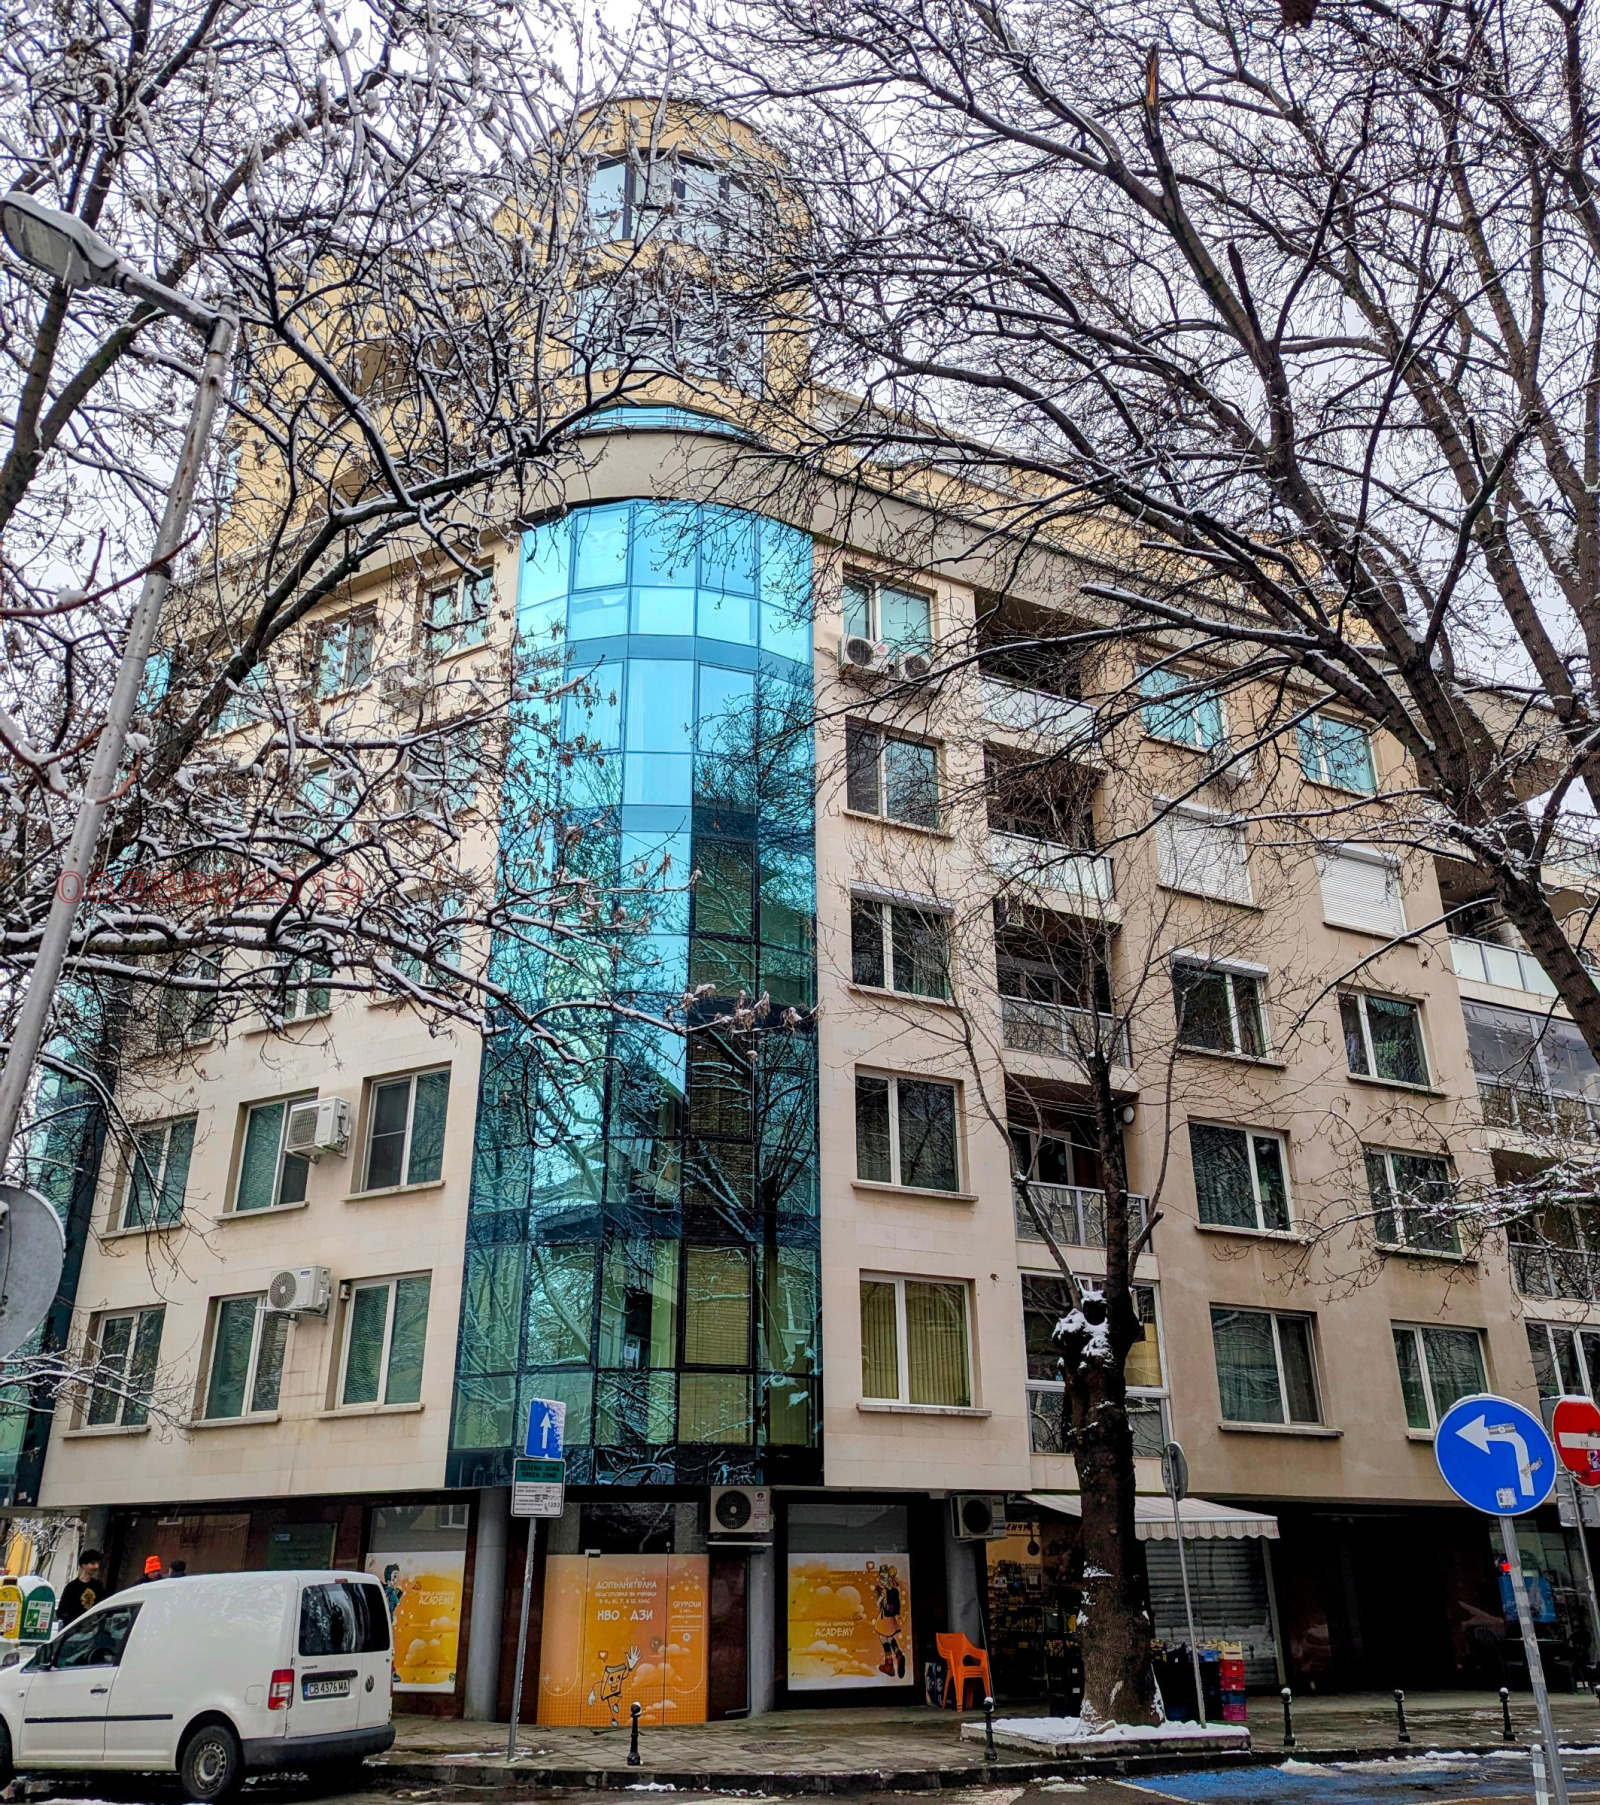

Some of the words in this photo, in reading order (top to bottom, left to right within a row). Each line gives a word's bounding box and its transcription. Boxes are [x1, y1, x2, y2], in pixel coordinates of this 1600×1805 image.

[596, 1581, 657, 1589] ДОПЪЛНИТЕЛНА
[418, 1596, 455, 1605] ACADEMY
[598, 1610, 620, 1620] НВО
[815, 1628, 855, 1637] ACADEMY
[308, 1683, 320, 1695] CB
[320, 1682, 338, 1694] 4376
[338, 1681, 348, 1692] MA
